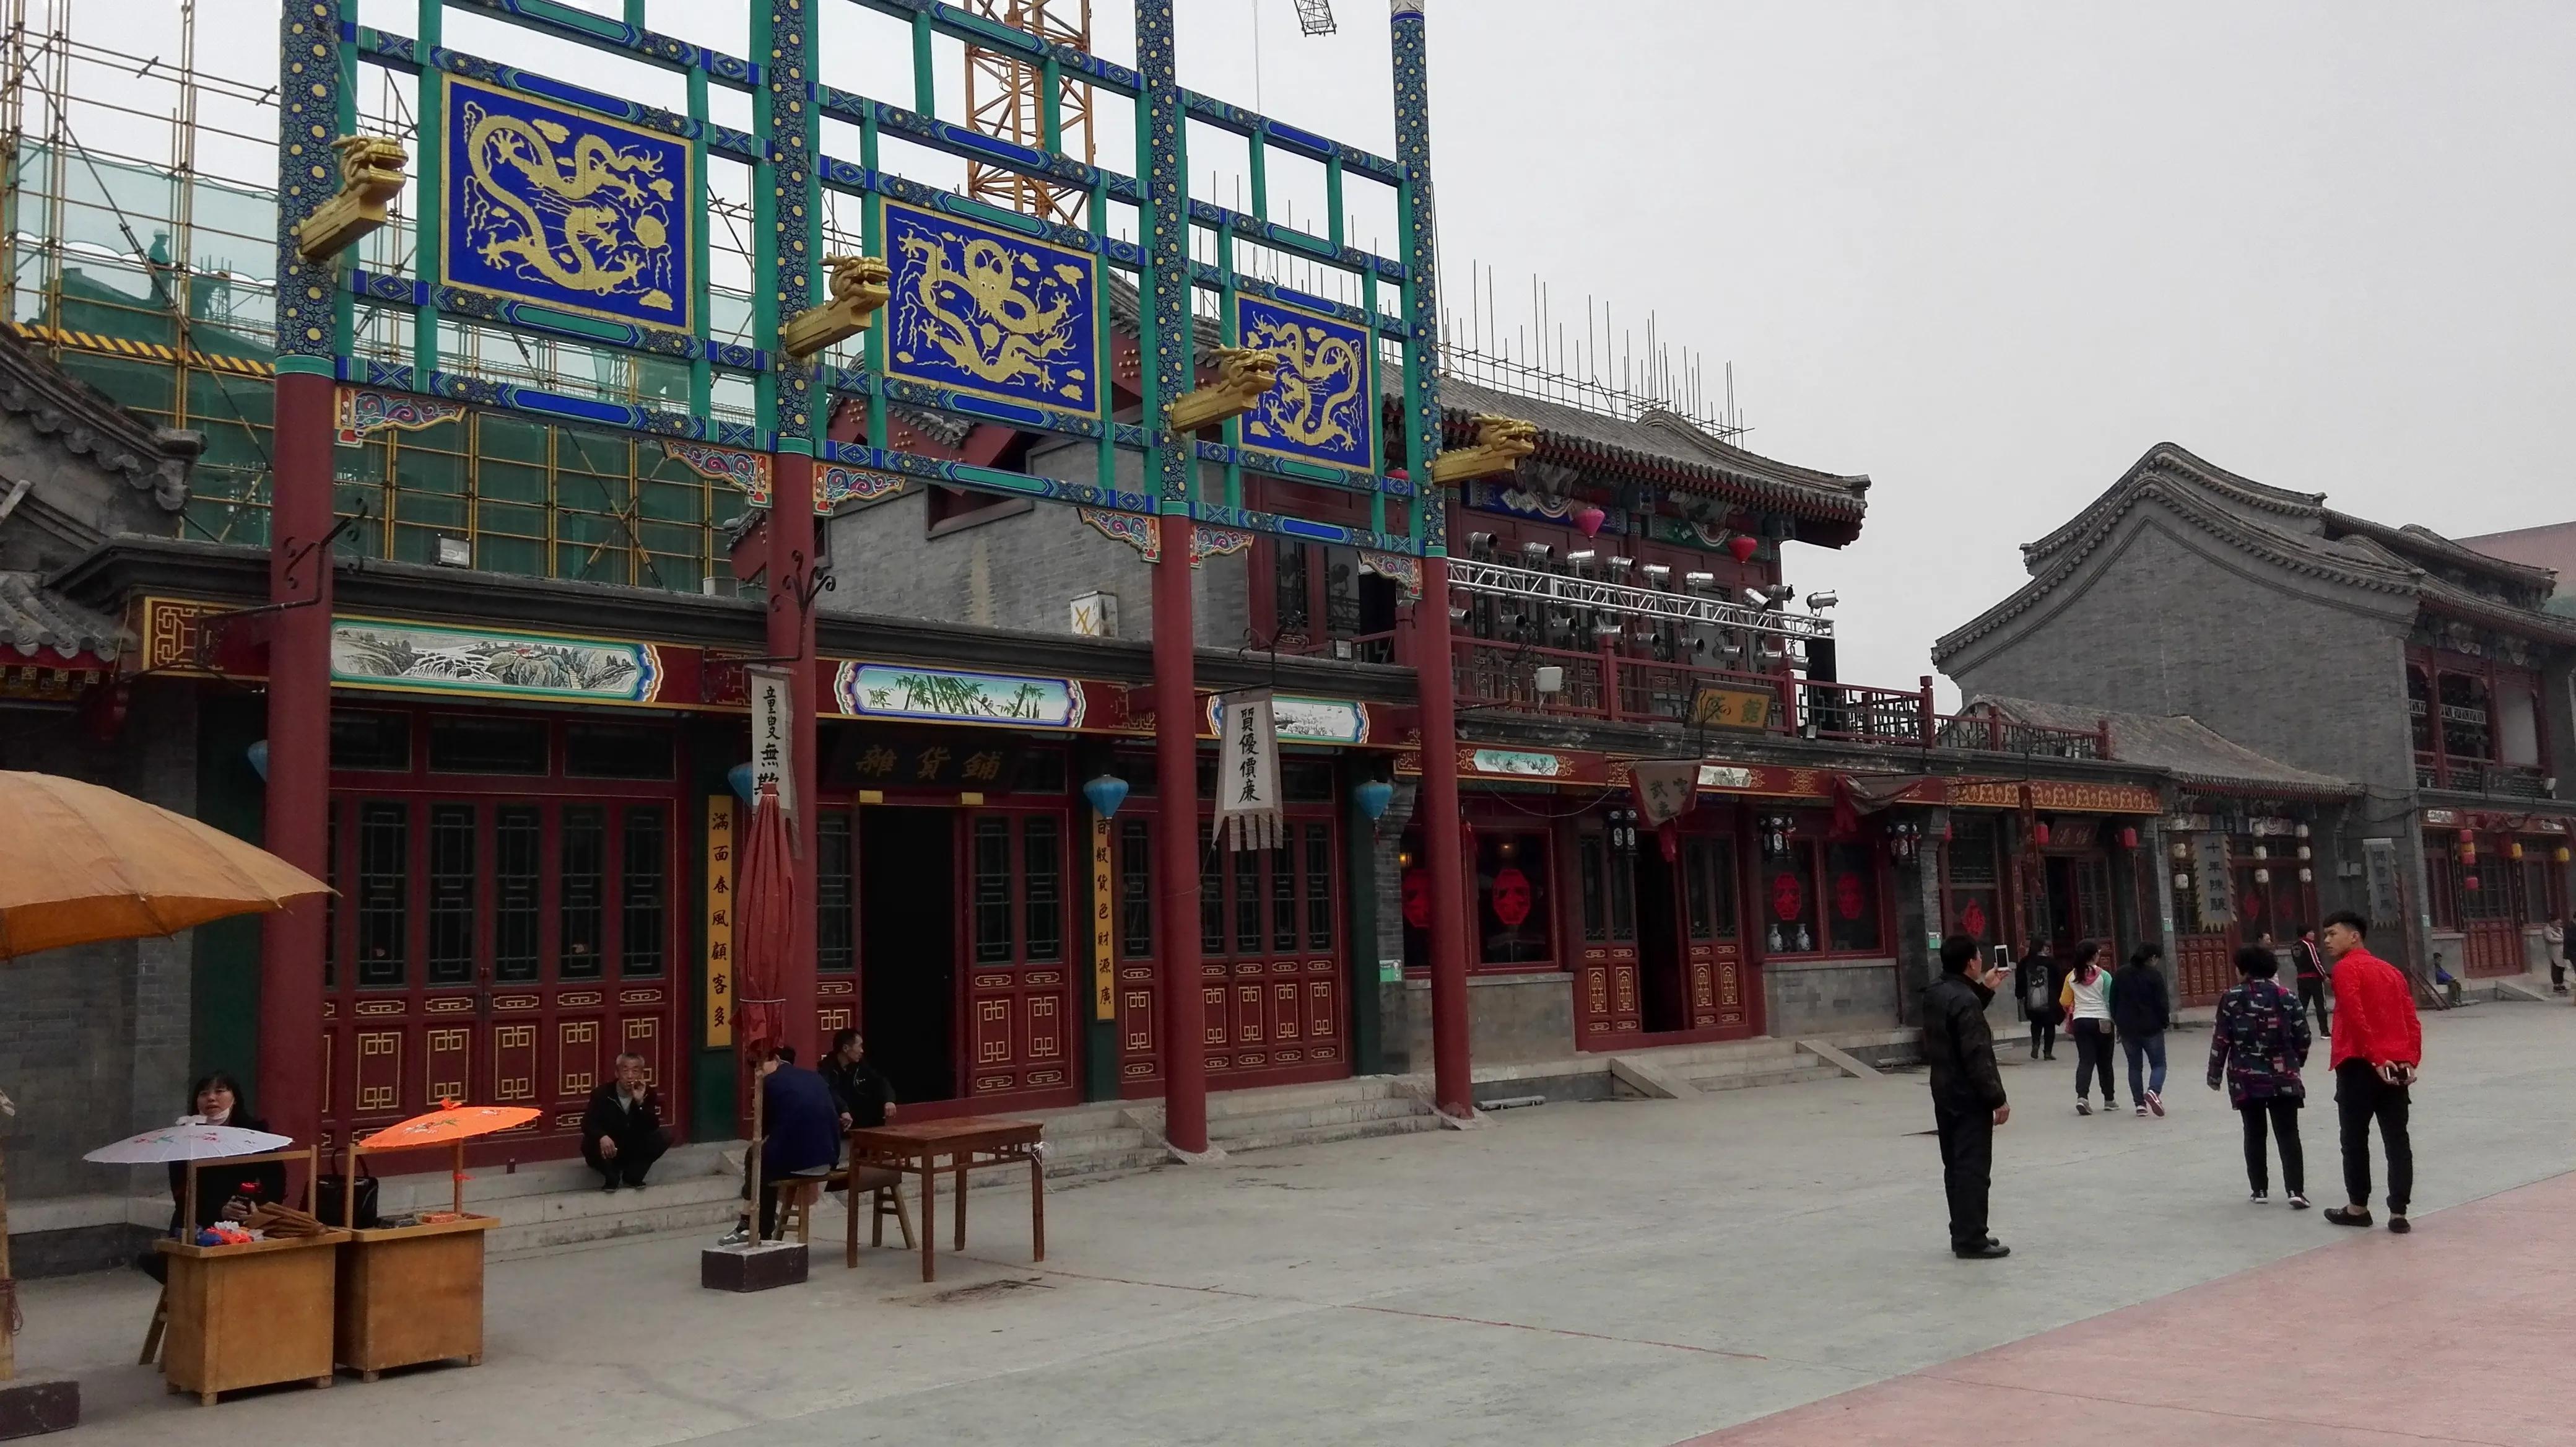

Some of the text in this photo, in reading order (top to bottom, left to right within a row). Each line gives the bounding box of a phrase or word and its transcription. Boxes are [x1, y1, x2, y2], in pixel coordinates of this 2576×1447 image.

[1237, 708, 1261, 803] 質優價廉
[711, 812, 729, 1028] 滿面春風顧客多
[1096, 819, 1112, 1005] 百般貨色財源廣
